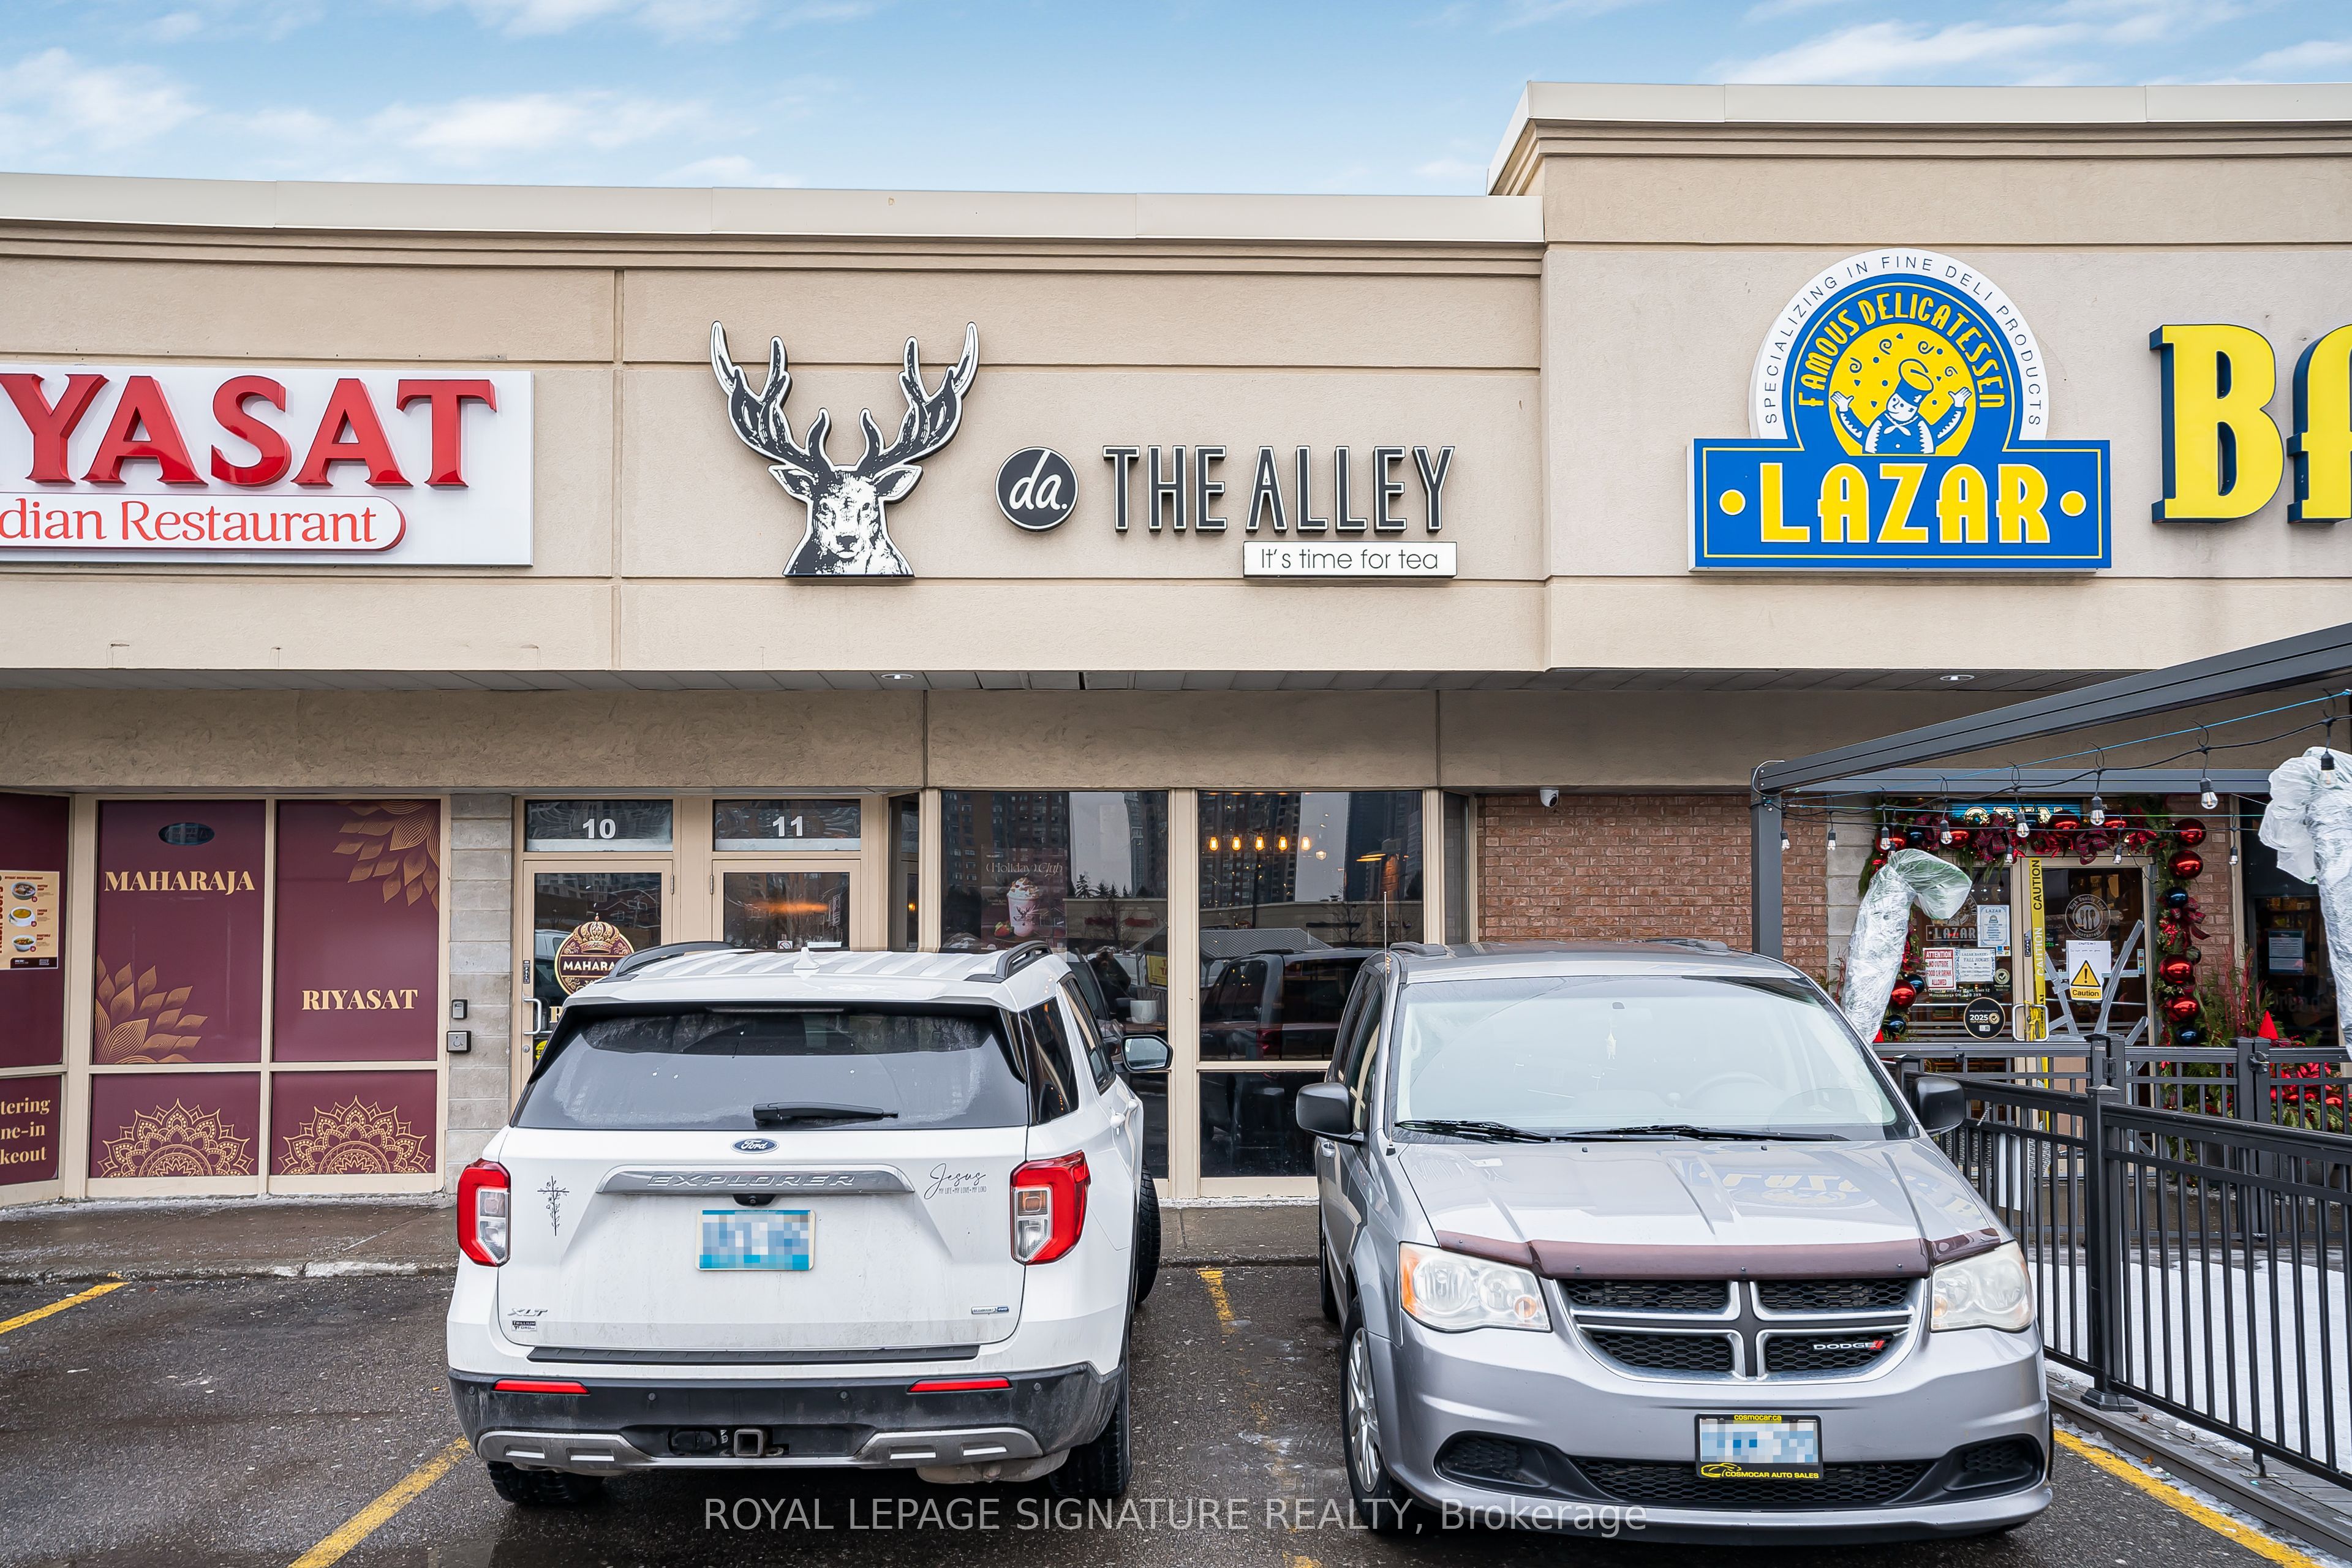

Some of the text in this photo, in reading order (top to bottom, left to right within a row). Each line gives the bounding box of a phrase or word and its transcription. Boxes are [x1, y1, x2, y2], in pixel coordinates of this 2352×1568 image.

[1765, 255, 2042, 426] SPECIALIZING IN FINE DELI PRODUCTS
[1798, 291, 2006, 409] FAMOUS DELICATESSEN
[1102, 445, 1456, 533] THE ALLEY
[1759, 462, 2050, 543] LAZAR
[121, 500, 377, 543] Restaurant
[1261, 548, 1439, 570] It's time for tea
[582, 818, 616, 840] 10
[772, 815, 804, 837] 11
[104, 870, 255, 895] MAHARAJA
[2032, 859, 2043, 910] CAUTION
[1934, 927, 1977, 939] LAZAR
[563, 961, 614, 971] MAHARA
[302, 989, 419, 1011] RIYASAT
[740, 1139, 767, 1150] Ford
[647, 1175, 856, 1187] EXPLORER
[924, 1163, 987, 1200] Jesus
[507, 1308, 548, 1317] XLT
[1813, 1341, 1877, 1350] DODGE
